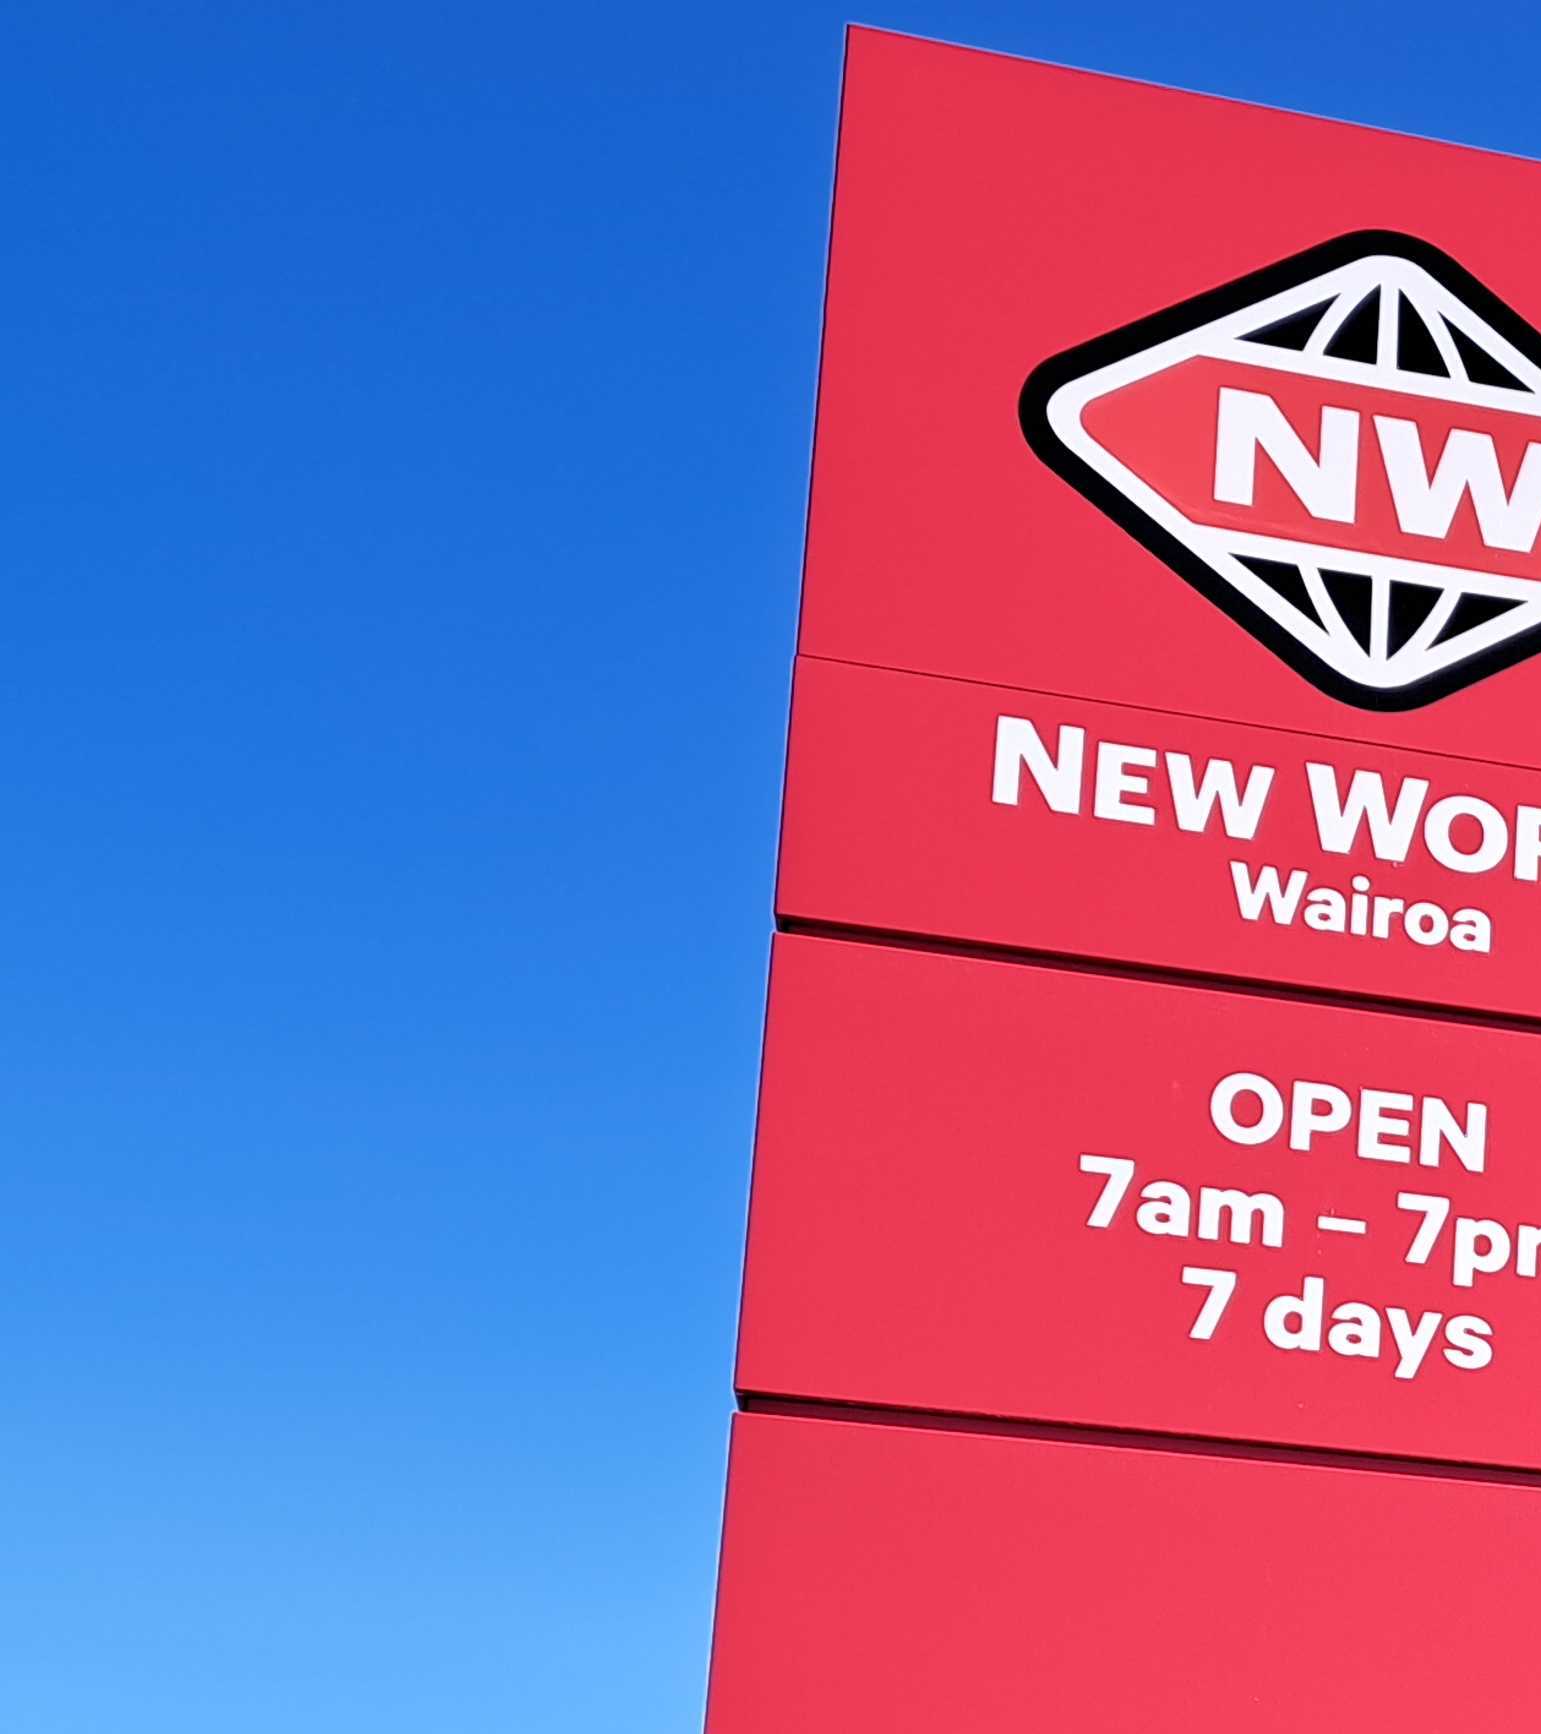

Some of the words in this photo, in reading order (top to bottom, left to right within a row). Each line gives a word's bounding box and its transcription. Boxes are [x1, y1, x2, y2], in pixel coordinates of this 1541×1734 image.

[991, 715, 1275, 841] NEW
[1229, 860, 1492, 954] Wairoa
[1209, 1072, 1488, 1174] OPEN
[1079, 1154, 1285, 1249] 7am
[1181, 1266, 1238, 1341] 7
[1263, 1275, 1493, 1380] days
